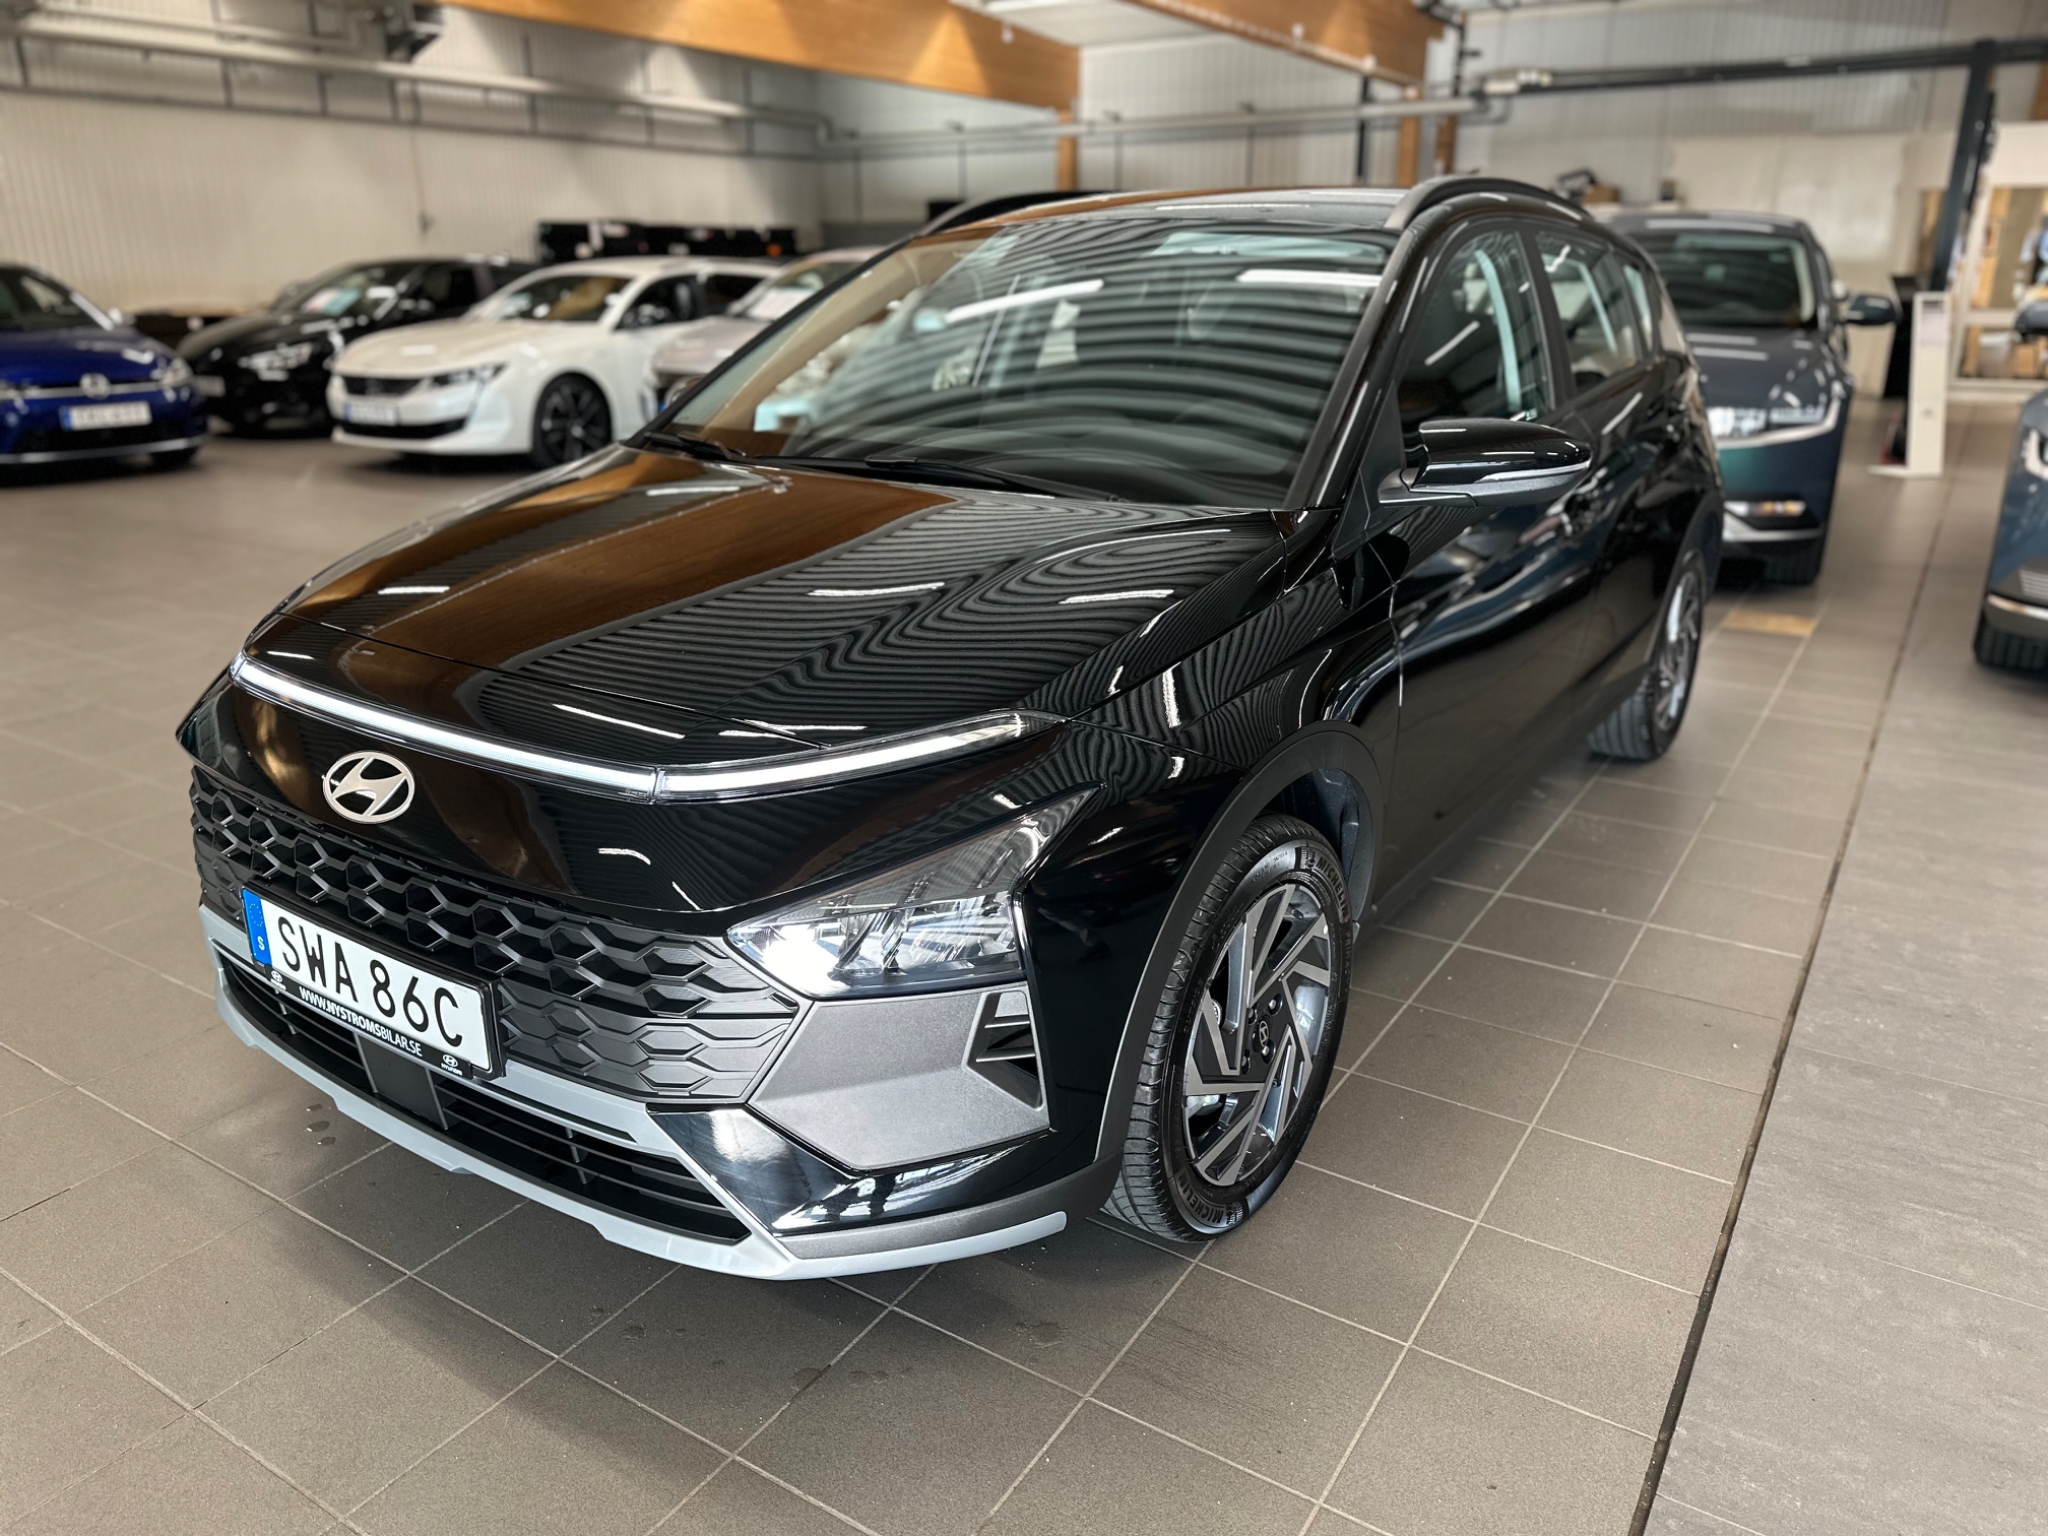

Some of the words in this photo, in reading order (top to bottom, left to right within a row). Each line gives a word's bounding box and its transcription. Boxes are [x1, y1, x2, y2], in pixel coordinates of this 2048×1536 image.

[1315, 856, 1350, 918] MICHELIN
[257, 935, 265, 951] S
[278, 916, 359, 1003] SWA
[369, 959, 463, 1048] 86C
[299, 985, 423, 1057] WWW.NYSTROMSBILAR.SE
[1178, 1173, 1224, 1224] MICHELIN
